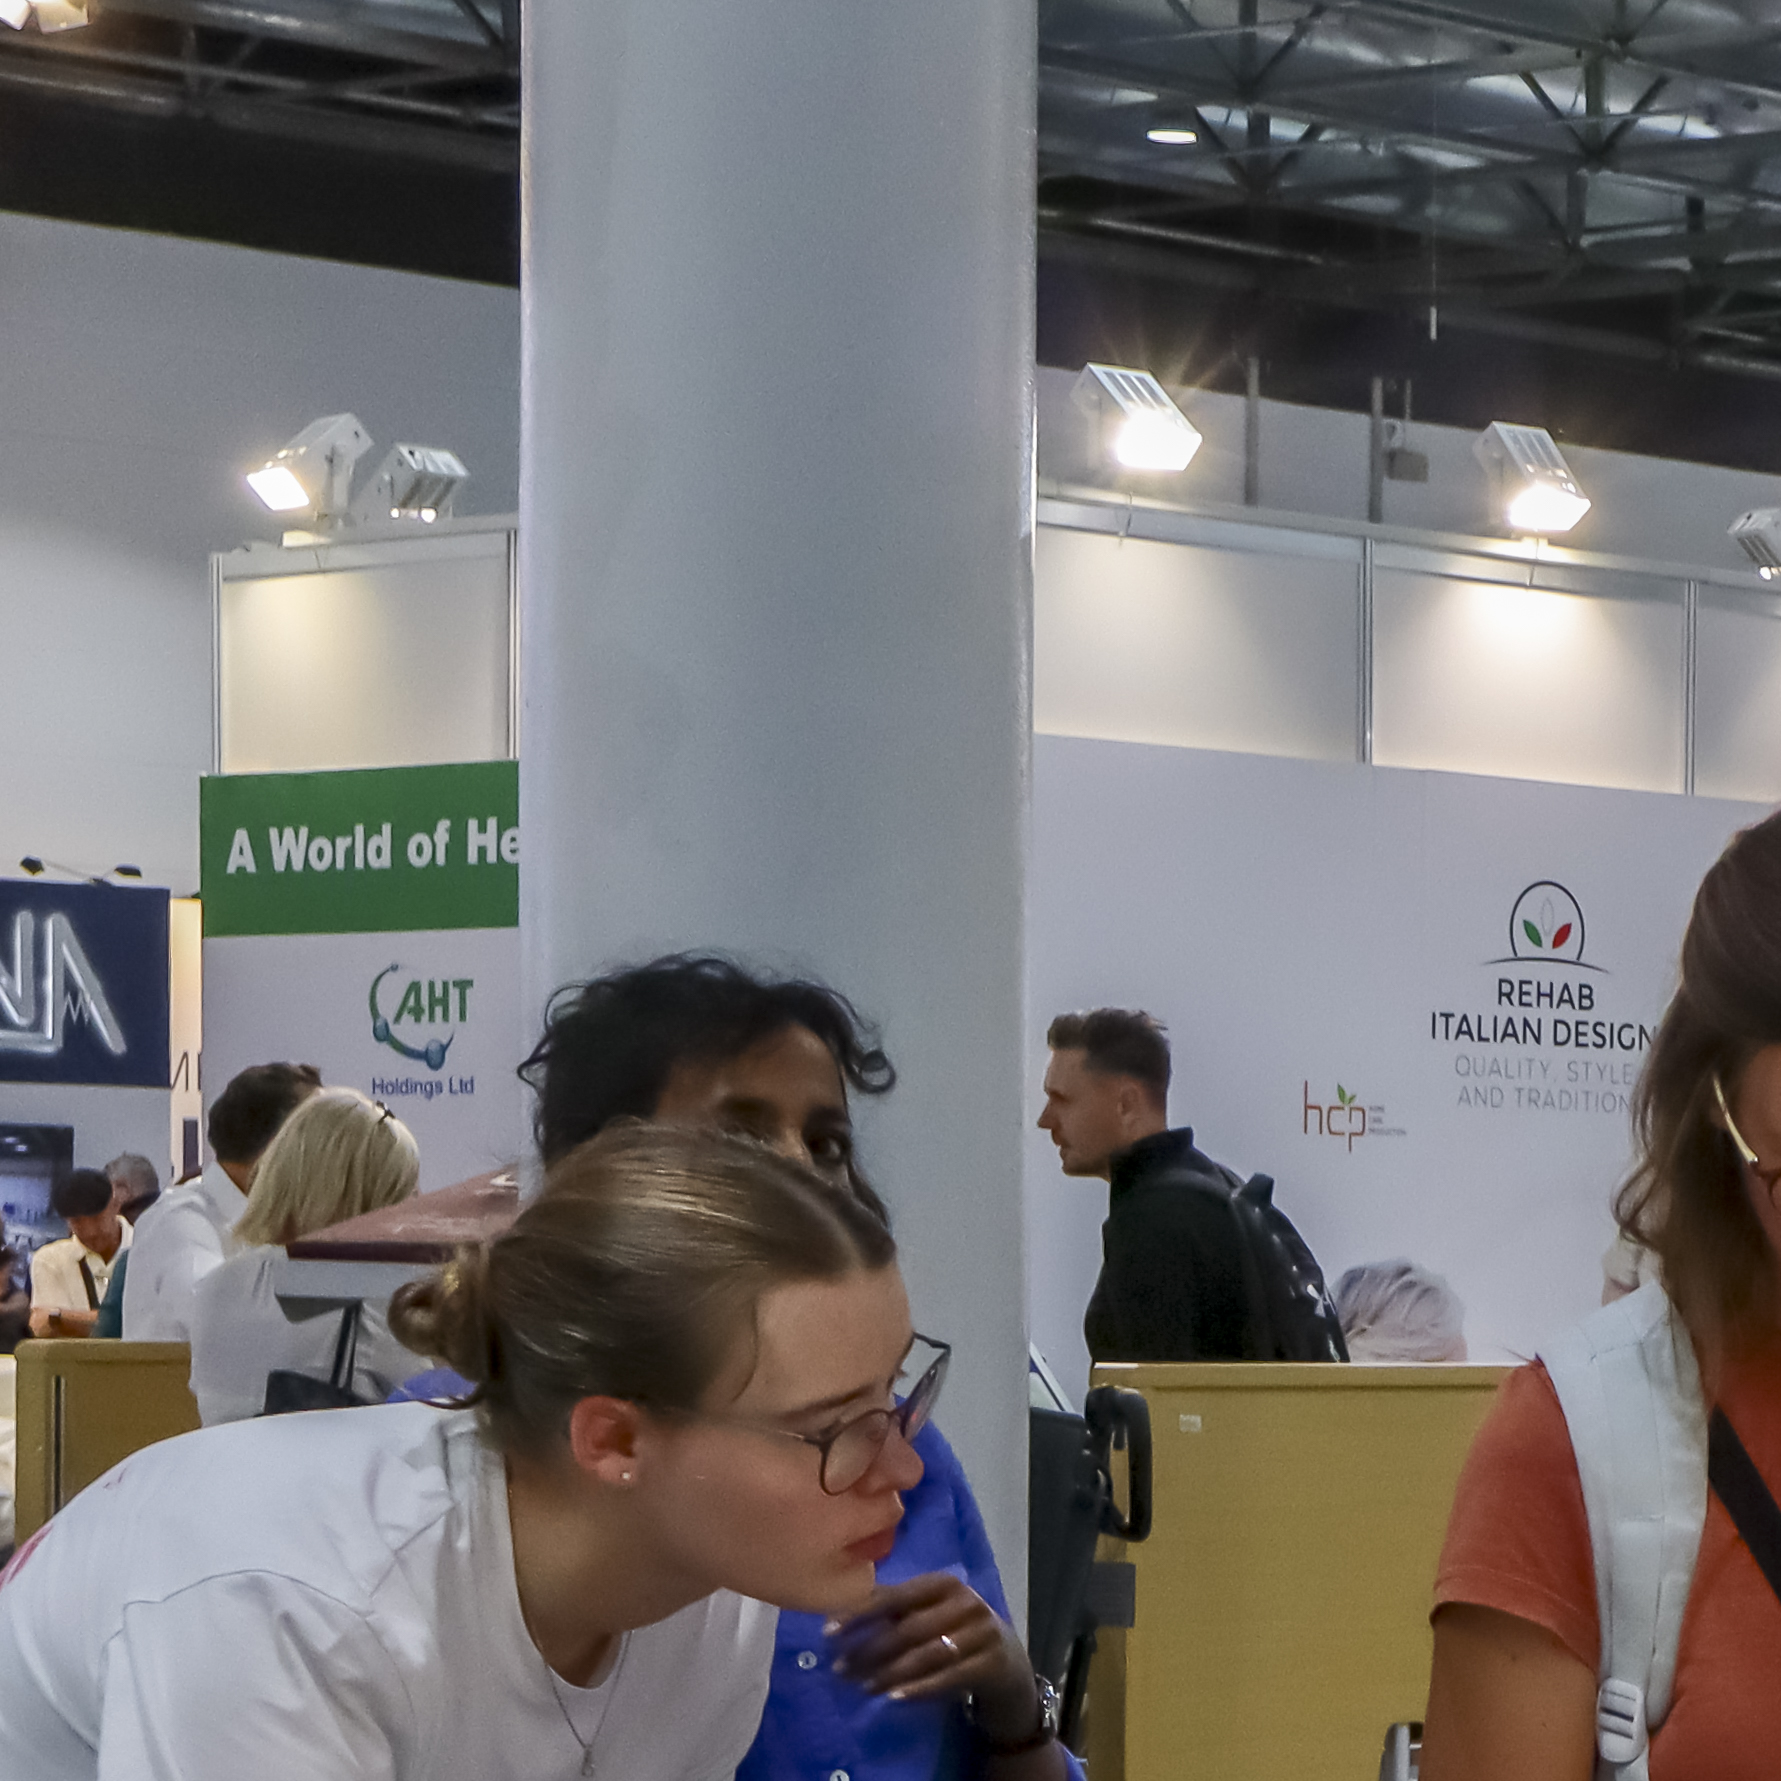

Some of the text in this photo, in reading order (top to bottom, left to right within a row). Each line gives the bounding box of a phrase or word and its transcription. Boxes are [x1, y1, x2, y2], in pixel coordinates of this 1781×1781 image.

[226, 827, 257, 875] A
[269, 822, 392, 873] World
[407, 818, 451, 867] of
[393, 978, 474, 1025] AHT
[1497, 977, 1595, 1011] REHAB
[1431, 1011, 1658, 1052] ITALIAN DESIGN
[371, 1075, 475, 1100] Holdings Ltd
[1566, 1060, 1633, 1086] STYLE
[1456, 1086, 1632, 1114] AND TRADITION
